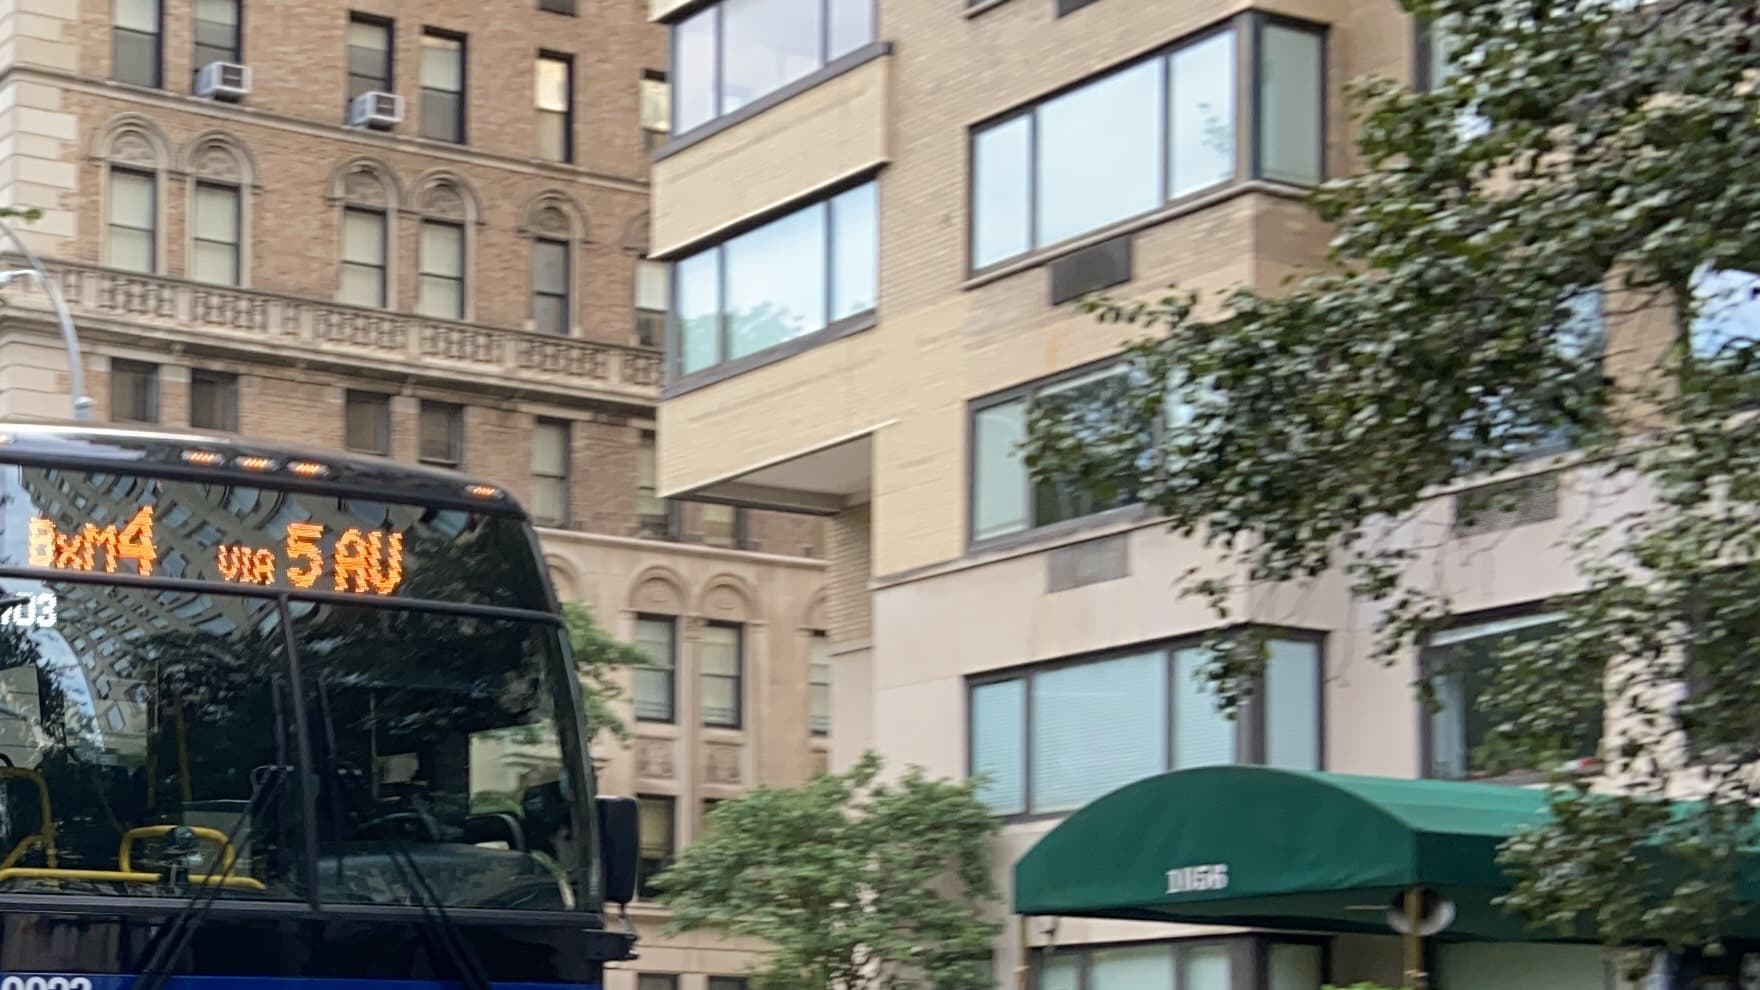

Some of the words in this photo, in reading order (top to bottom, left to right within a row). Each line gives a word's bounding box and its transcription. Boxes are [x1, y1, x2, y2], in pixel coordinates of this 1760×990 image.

[28, 505, 158, 576] BxM4
[216, 545, 276, 586] VIA
[286, 521, 325, 589] 5
[334, 528, 404, 595] AV
